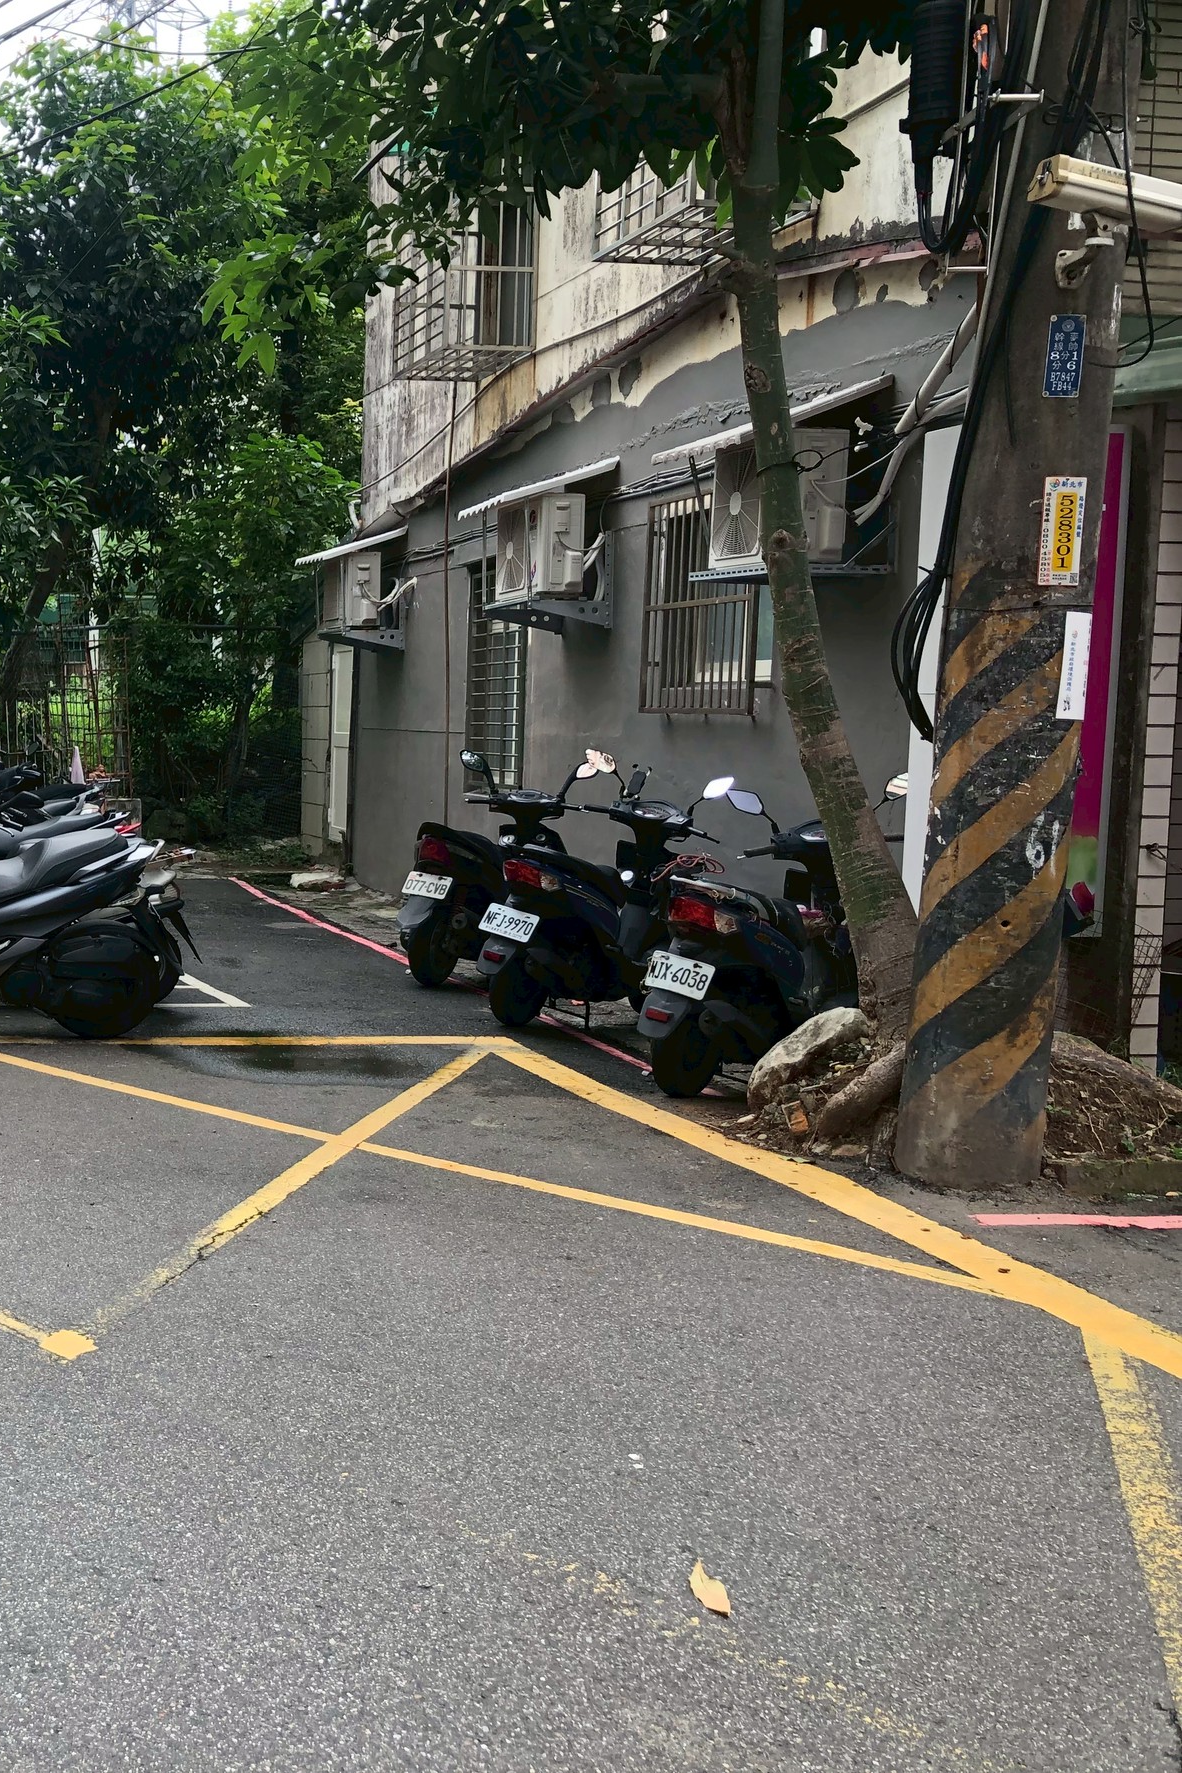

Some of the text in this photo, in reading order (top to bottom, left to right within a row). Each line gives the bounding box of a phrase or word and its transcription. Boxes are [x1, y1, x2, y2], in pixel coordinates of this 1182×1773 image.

[1050, 372, 1076, 382] B7847
[1051, 381, 1072, 391] FB44
[1056, 495, 1074, 569] 528301
